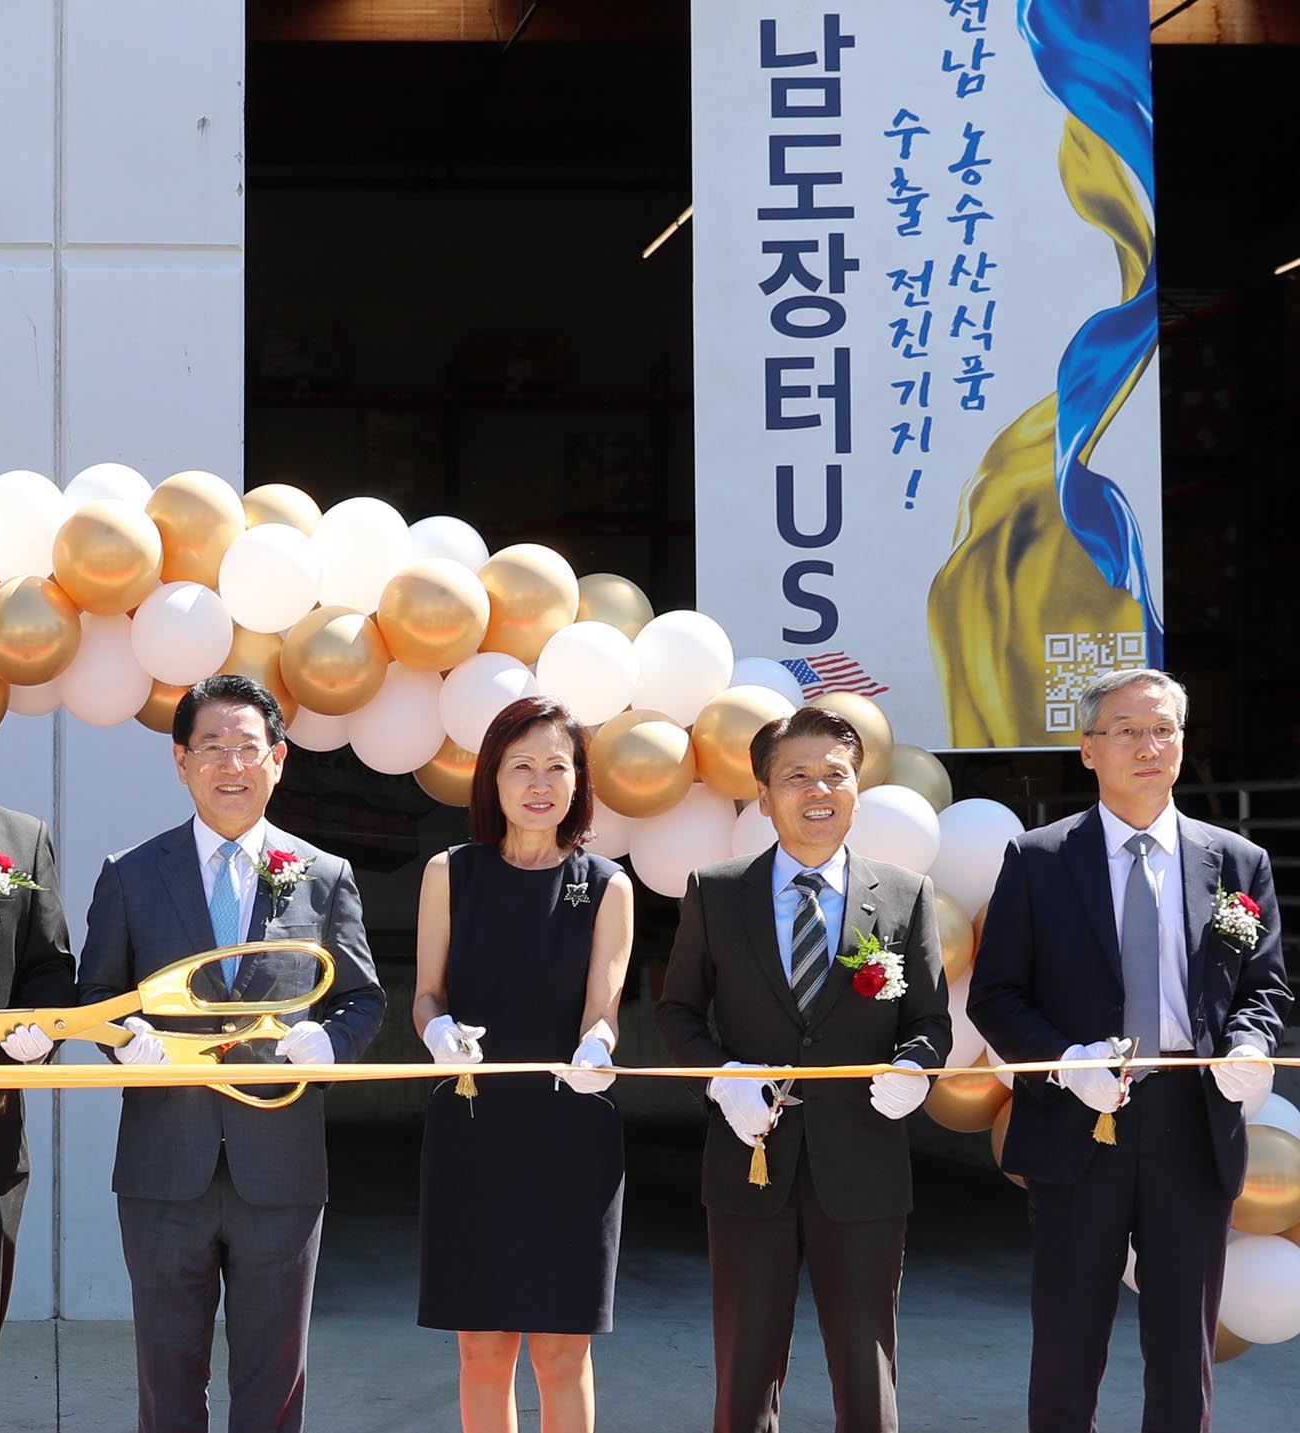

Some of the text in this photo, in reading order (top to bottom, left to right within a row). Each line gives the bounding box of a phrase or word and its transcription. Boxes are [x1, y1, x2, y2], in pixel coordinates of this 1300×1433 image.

[757, 14, 860, 645] 남도장터 US
[884, 109, 930, 236] 수출
[941, 0, 997, 411] 전남 농수산식품
